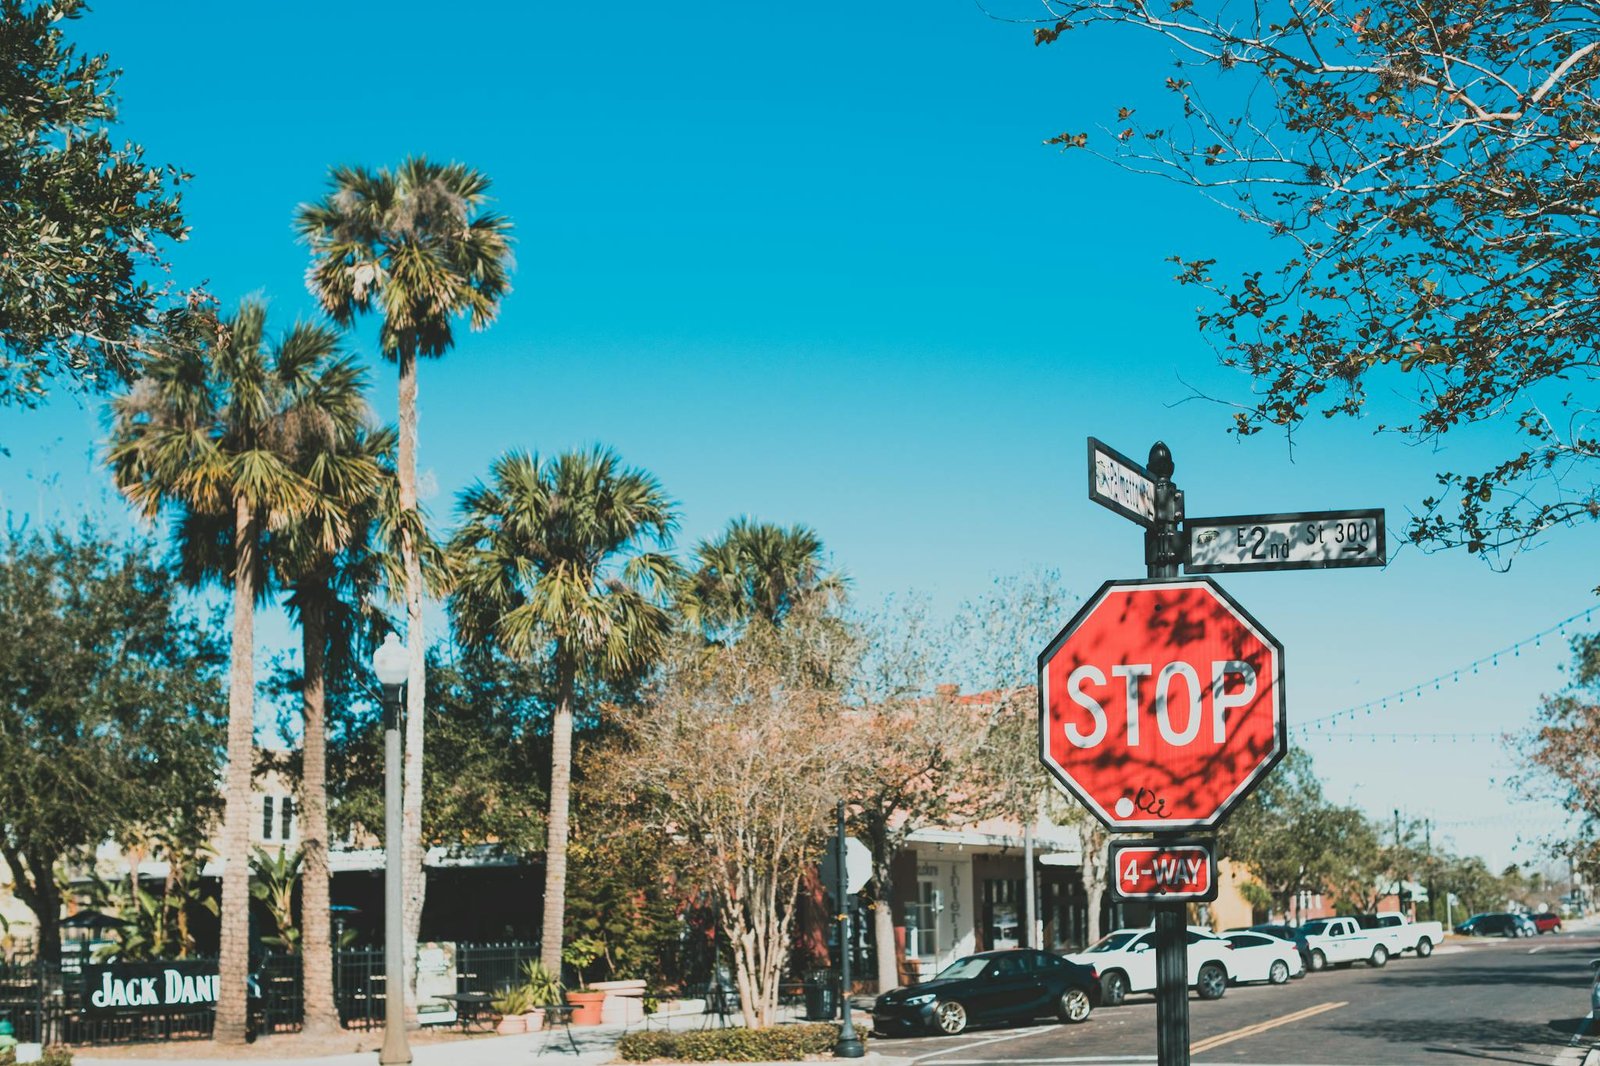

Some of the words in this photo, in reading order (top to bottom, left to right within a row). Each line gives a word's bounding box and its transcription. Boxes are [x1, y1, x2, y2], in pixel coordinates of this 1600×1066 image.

[1237, 527, 1247, 547] E
[1251, 526, 1290, 560] 2nd
[1306, 523, 1325, 545] St
[1335, 521, 1370, 544] 300
[1063, 660, 1258, 749] STOP
[1123, 858, 1203, 886] 4-WAY
[91, 971, 159, 1008] JACK
